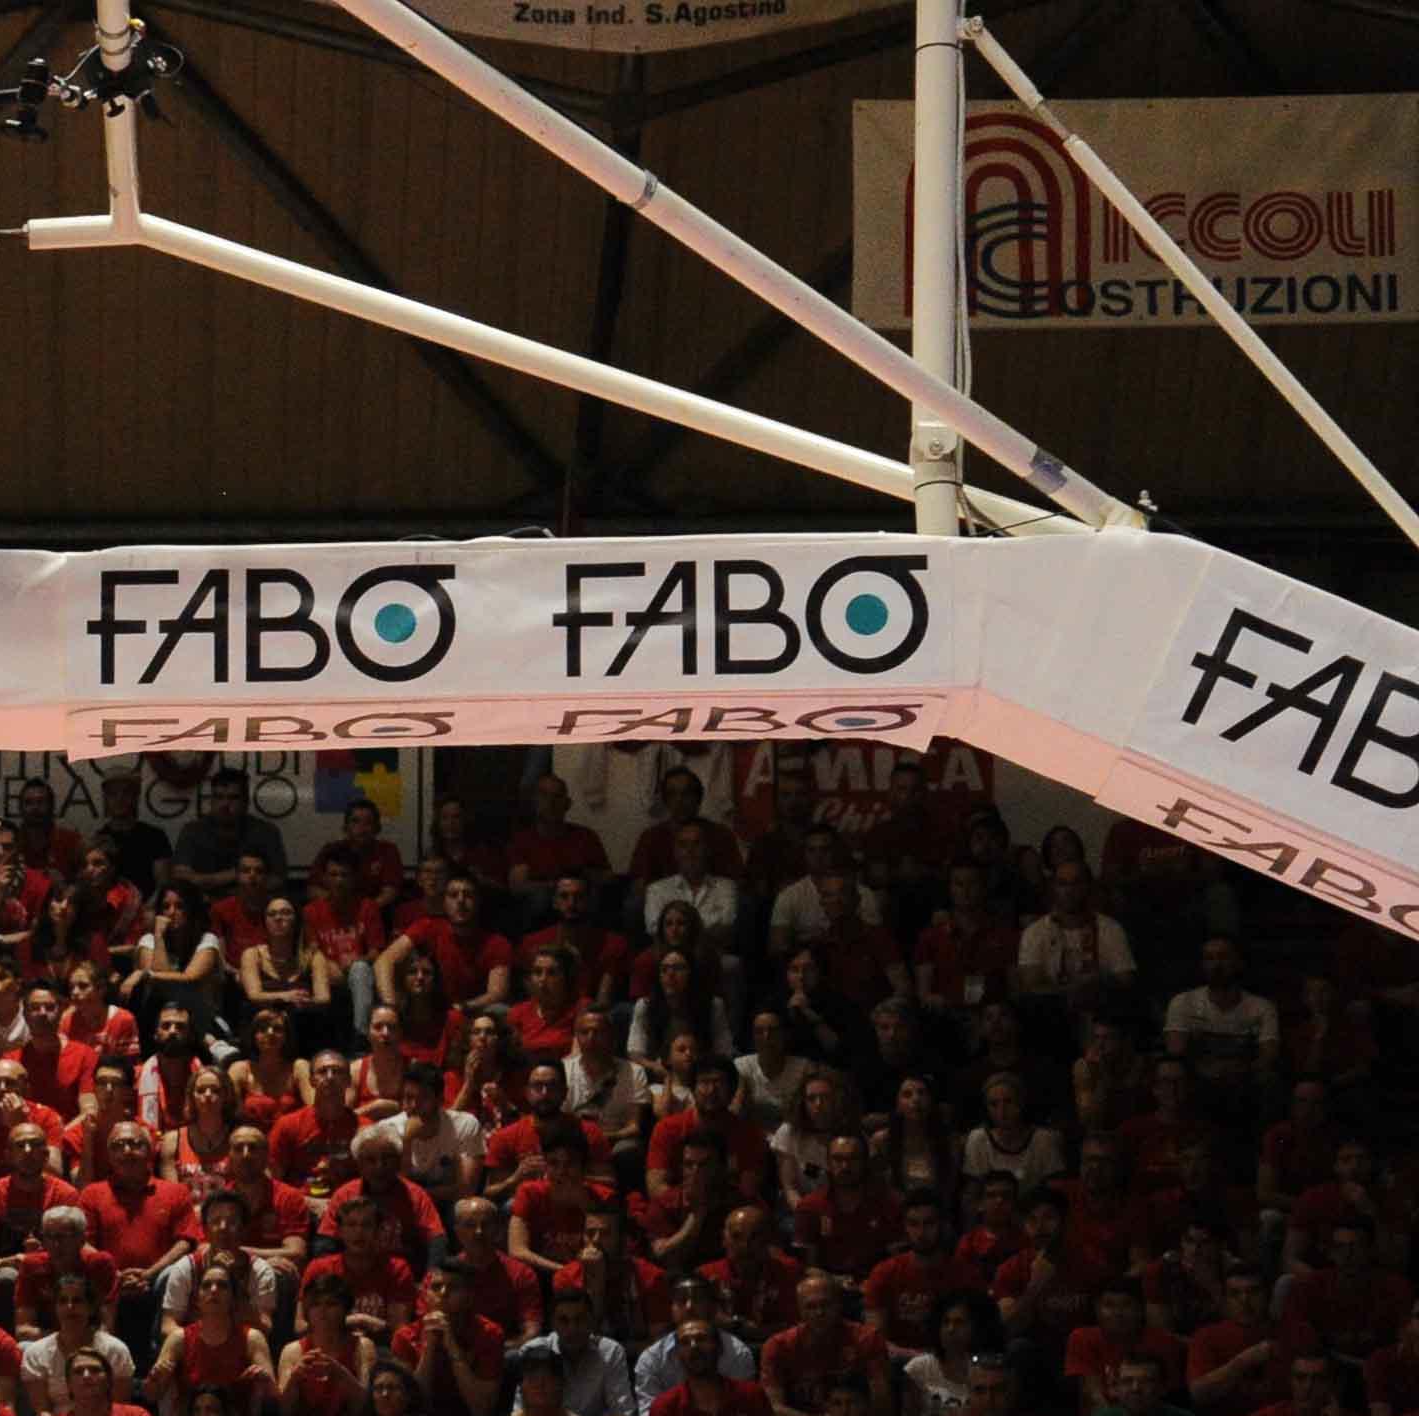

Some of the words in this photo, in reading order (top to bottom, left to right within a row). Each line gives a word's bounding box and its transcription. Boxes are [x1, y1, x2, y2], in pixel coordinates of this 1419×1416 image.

[514, 3, 575, 24] Zona
[587, 5, 634, 25] Ind.
[86, 563, 457, 685] FABO
[551, 554, 930, 676] FABO
[87, 711, 457, 747] FABO
[554, 702, 925, 738] FABO
